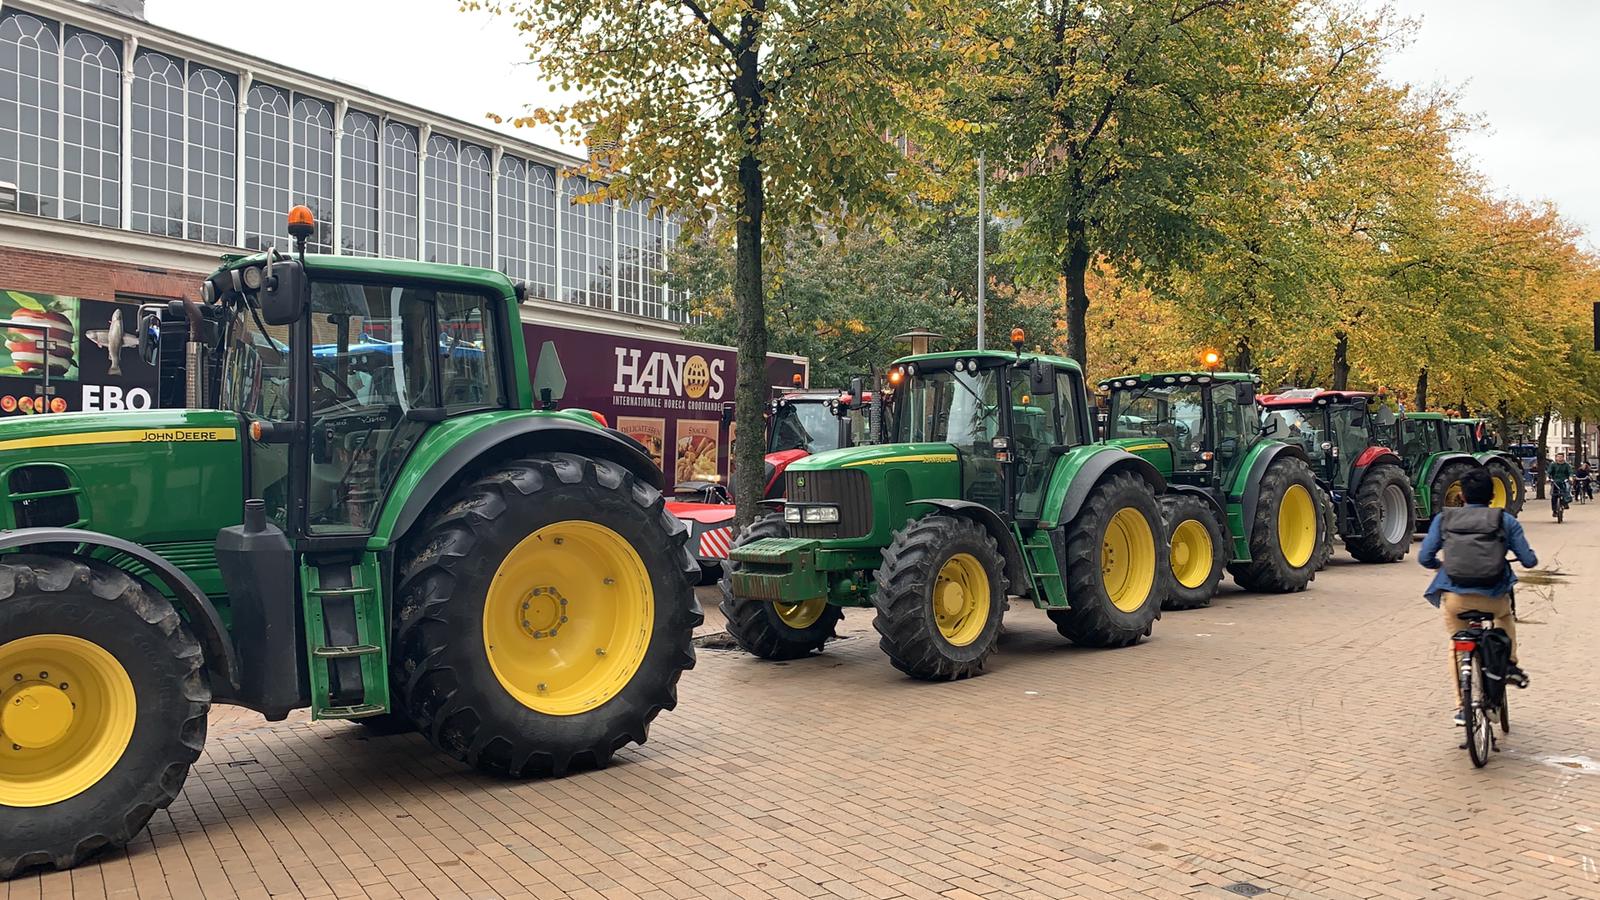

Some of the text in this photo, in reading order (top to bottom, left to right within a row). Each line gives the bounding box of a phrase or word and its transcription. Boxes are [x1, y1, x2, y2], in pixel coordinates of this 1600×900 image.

[613, 347, 725, 400] HANOS
[82, 384, 152, 411] EBO
[612, 395, 662, 408] INTERNATIONALE
[664, 399, 686, 410] HORECA
[141, 430, 217, 441] JOHN DEERE
